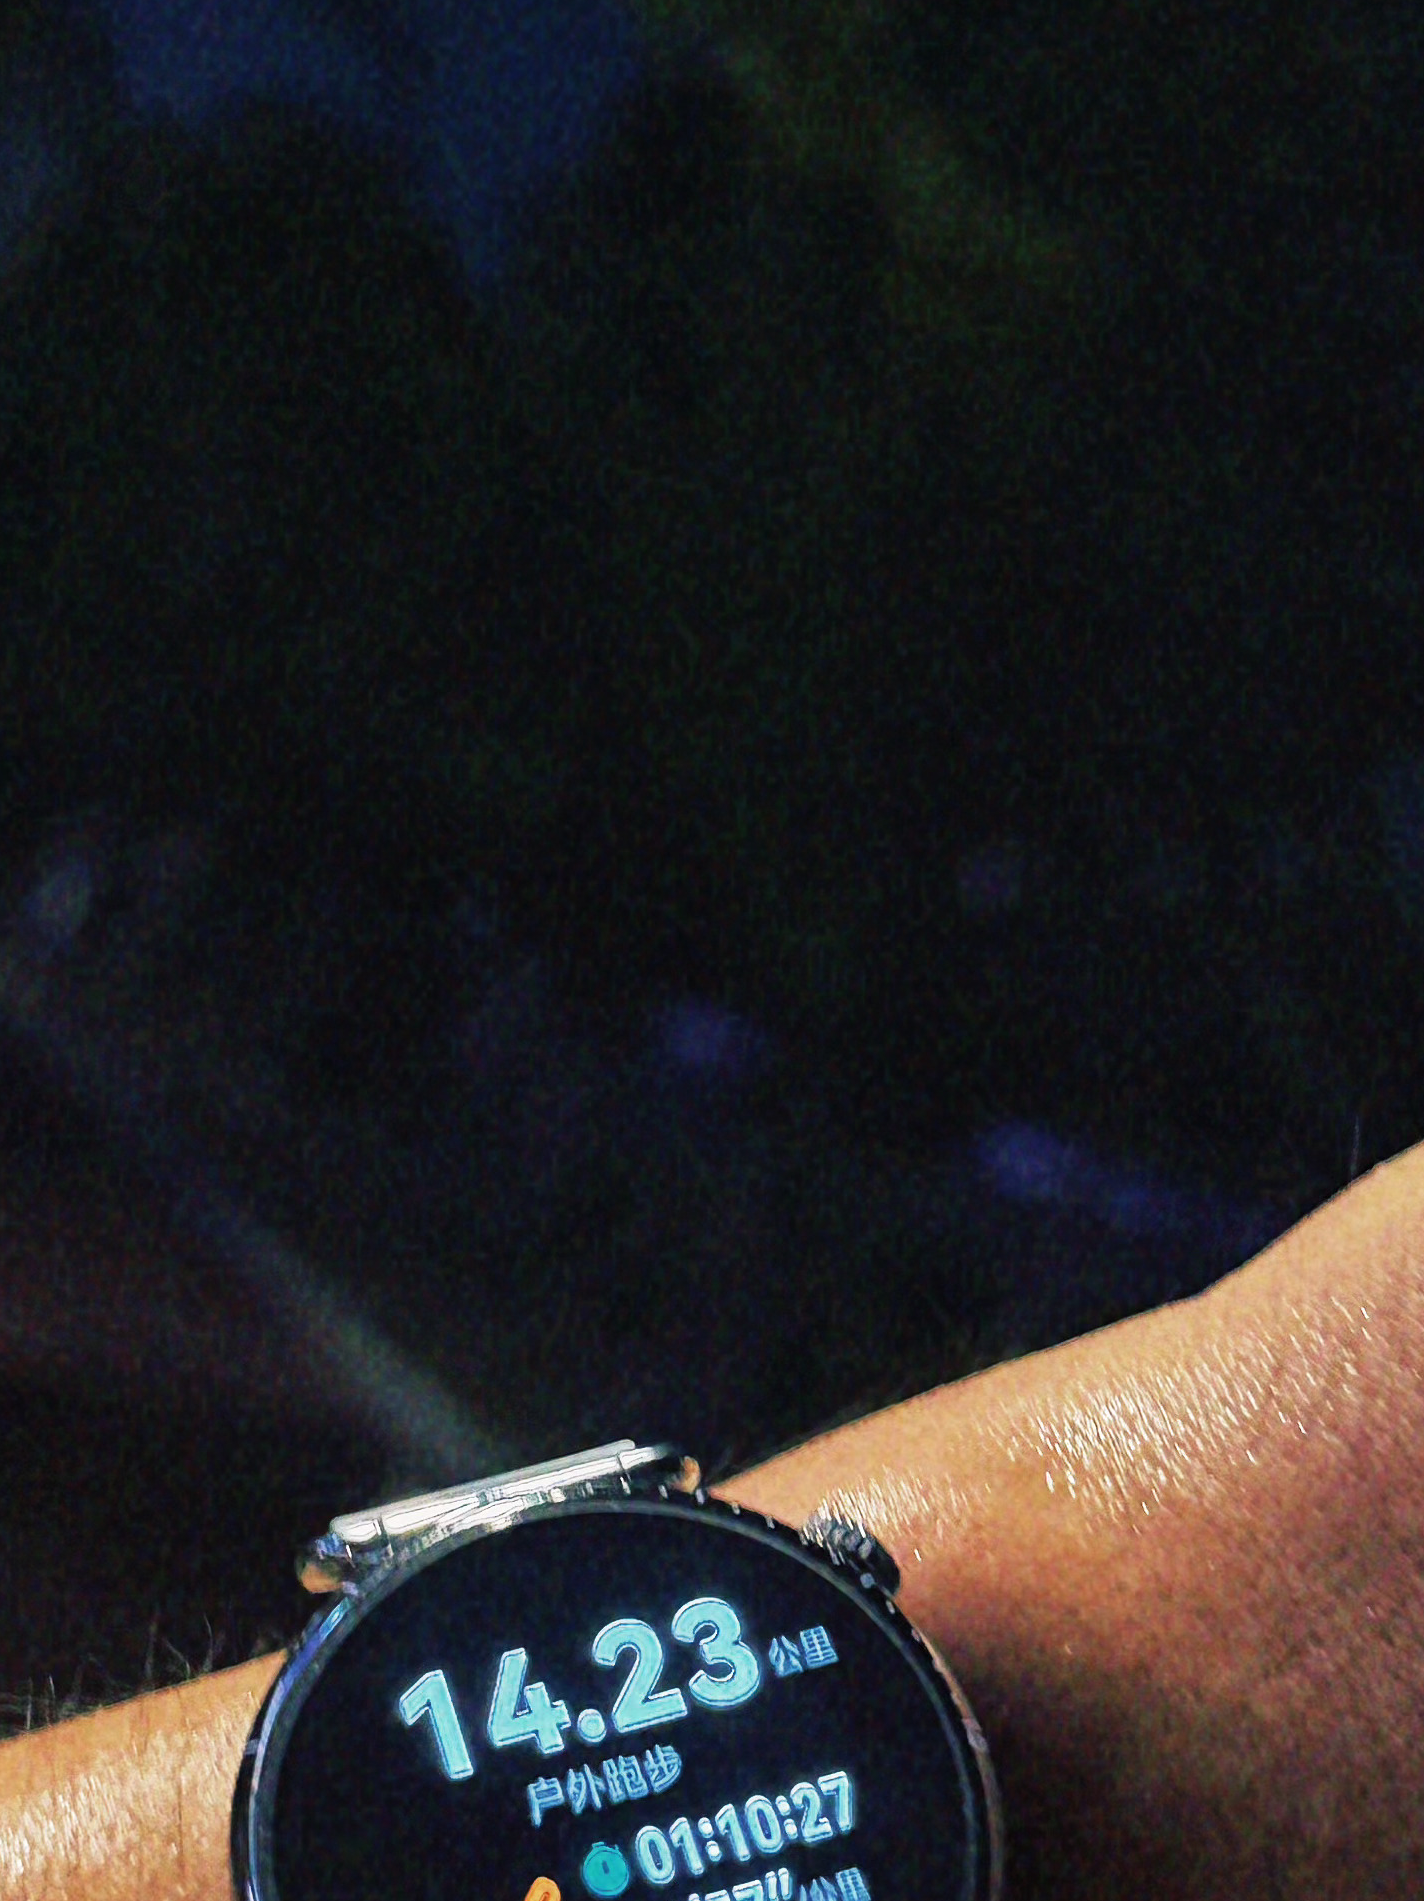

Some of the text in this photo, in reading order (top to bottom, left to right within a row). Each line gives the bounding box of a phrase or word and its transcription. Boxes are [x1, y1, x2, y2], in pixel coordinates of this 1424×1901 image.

[399, 1597, 838, 1780] 14.23 公里
[528, 1743, 683, 1827] 户外跑步
[634, 1770, 854, 1885] 01:10:27
